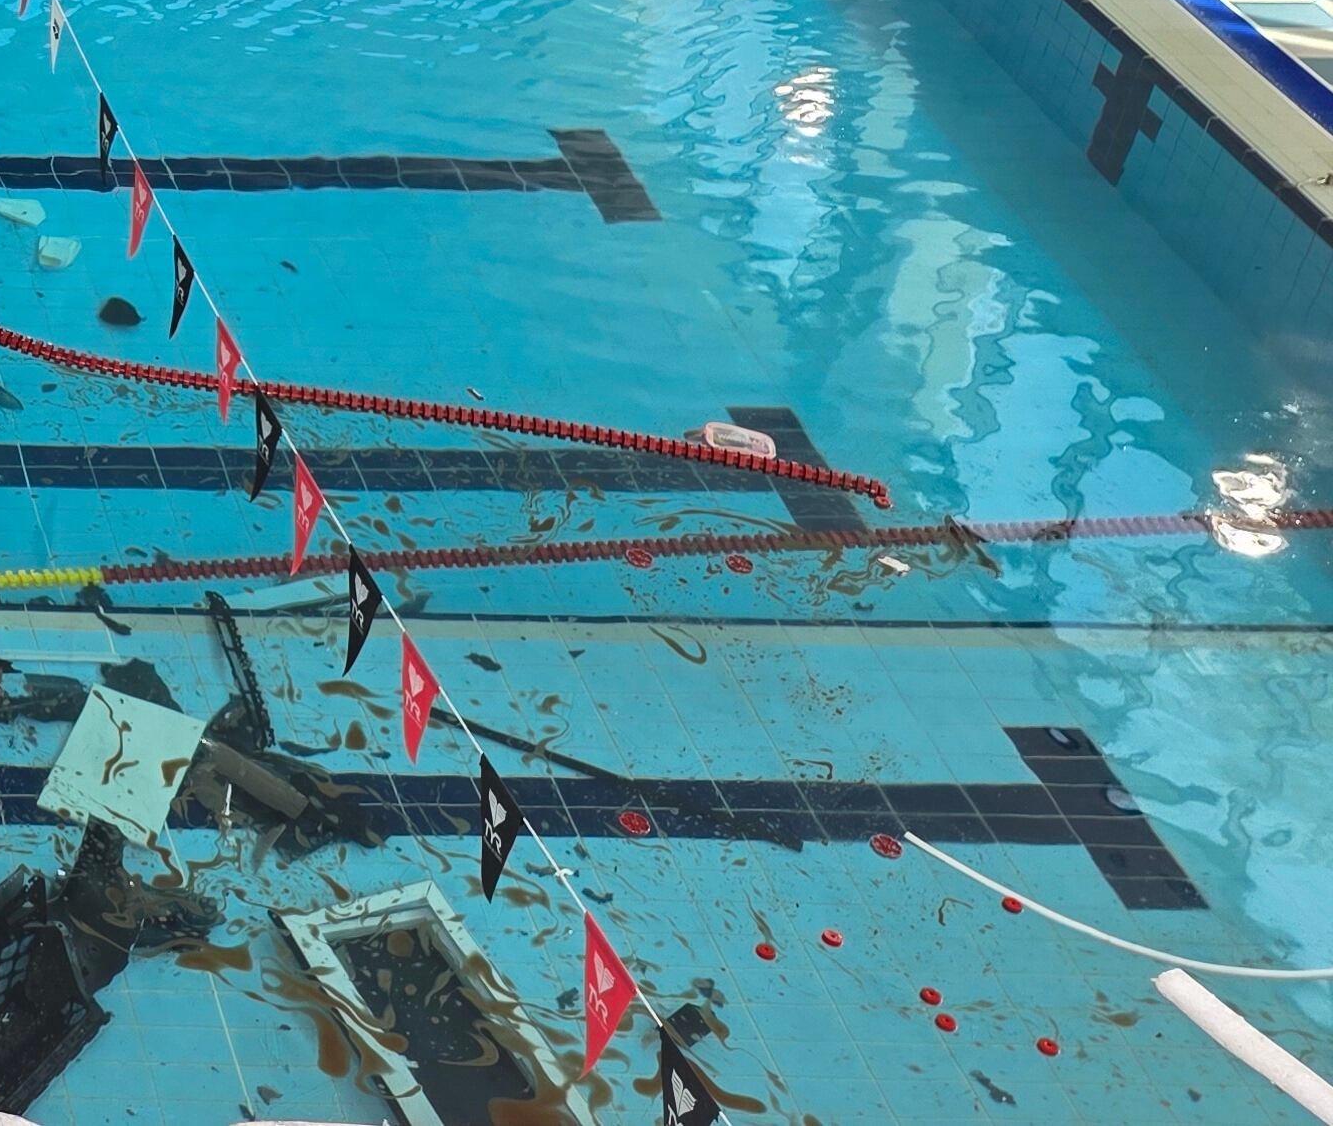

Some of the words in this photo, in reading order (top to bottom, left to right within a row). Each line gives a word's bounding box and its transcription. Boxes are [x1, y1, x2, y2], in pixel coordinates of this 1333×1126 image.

[351, 597, 364, 629] TYR
[405, 689, 422, 722] TYR
[484, 817, 503, 856] TYR
[589, 982, 609, 1025] TYR
